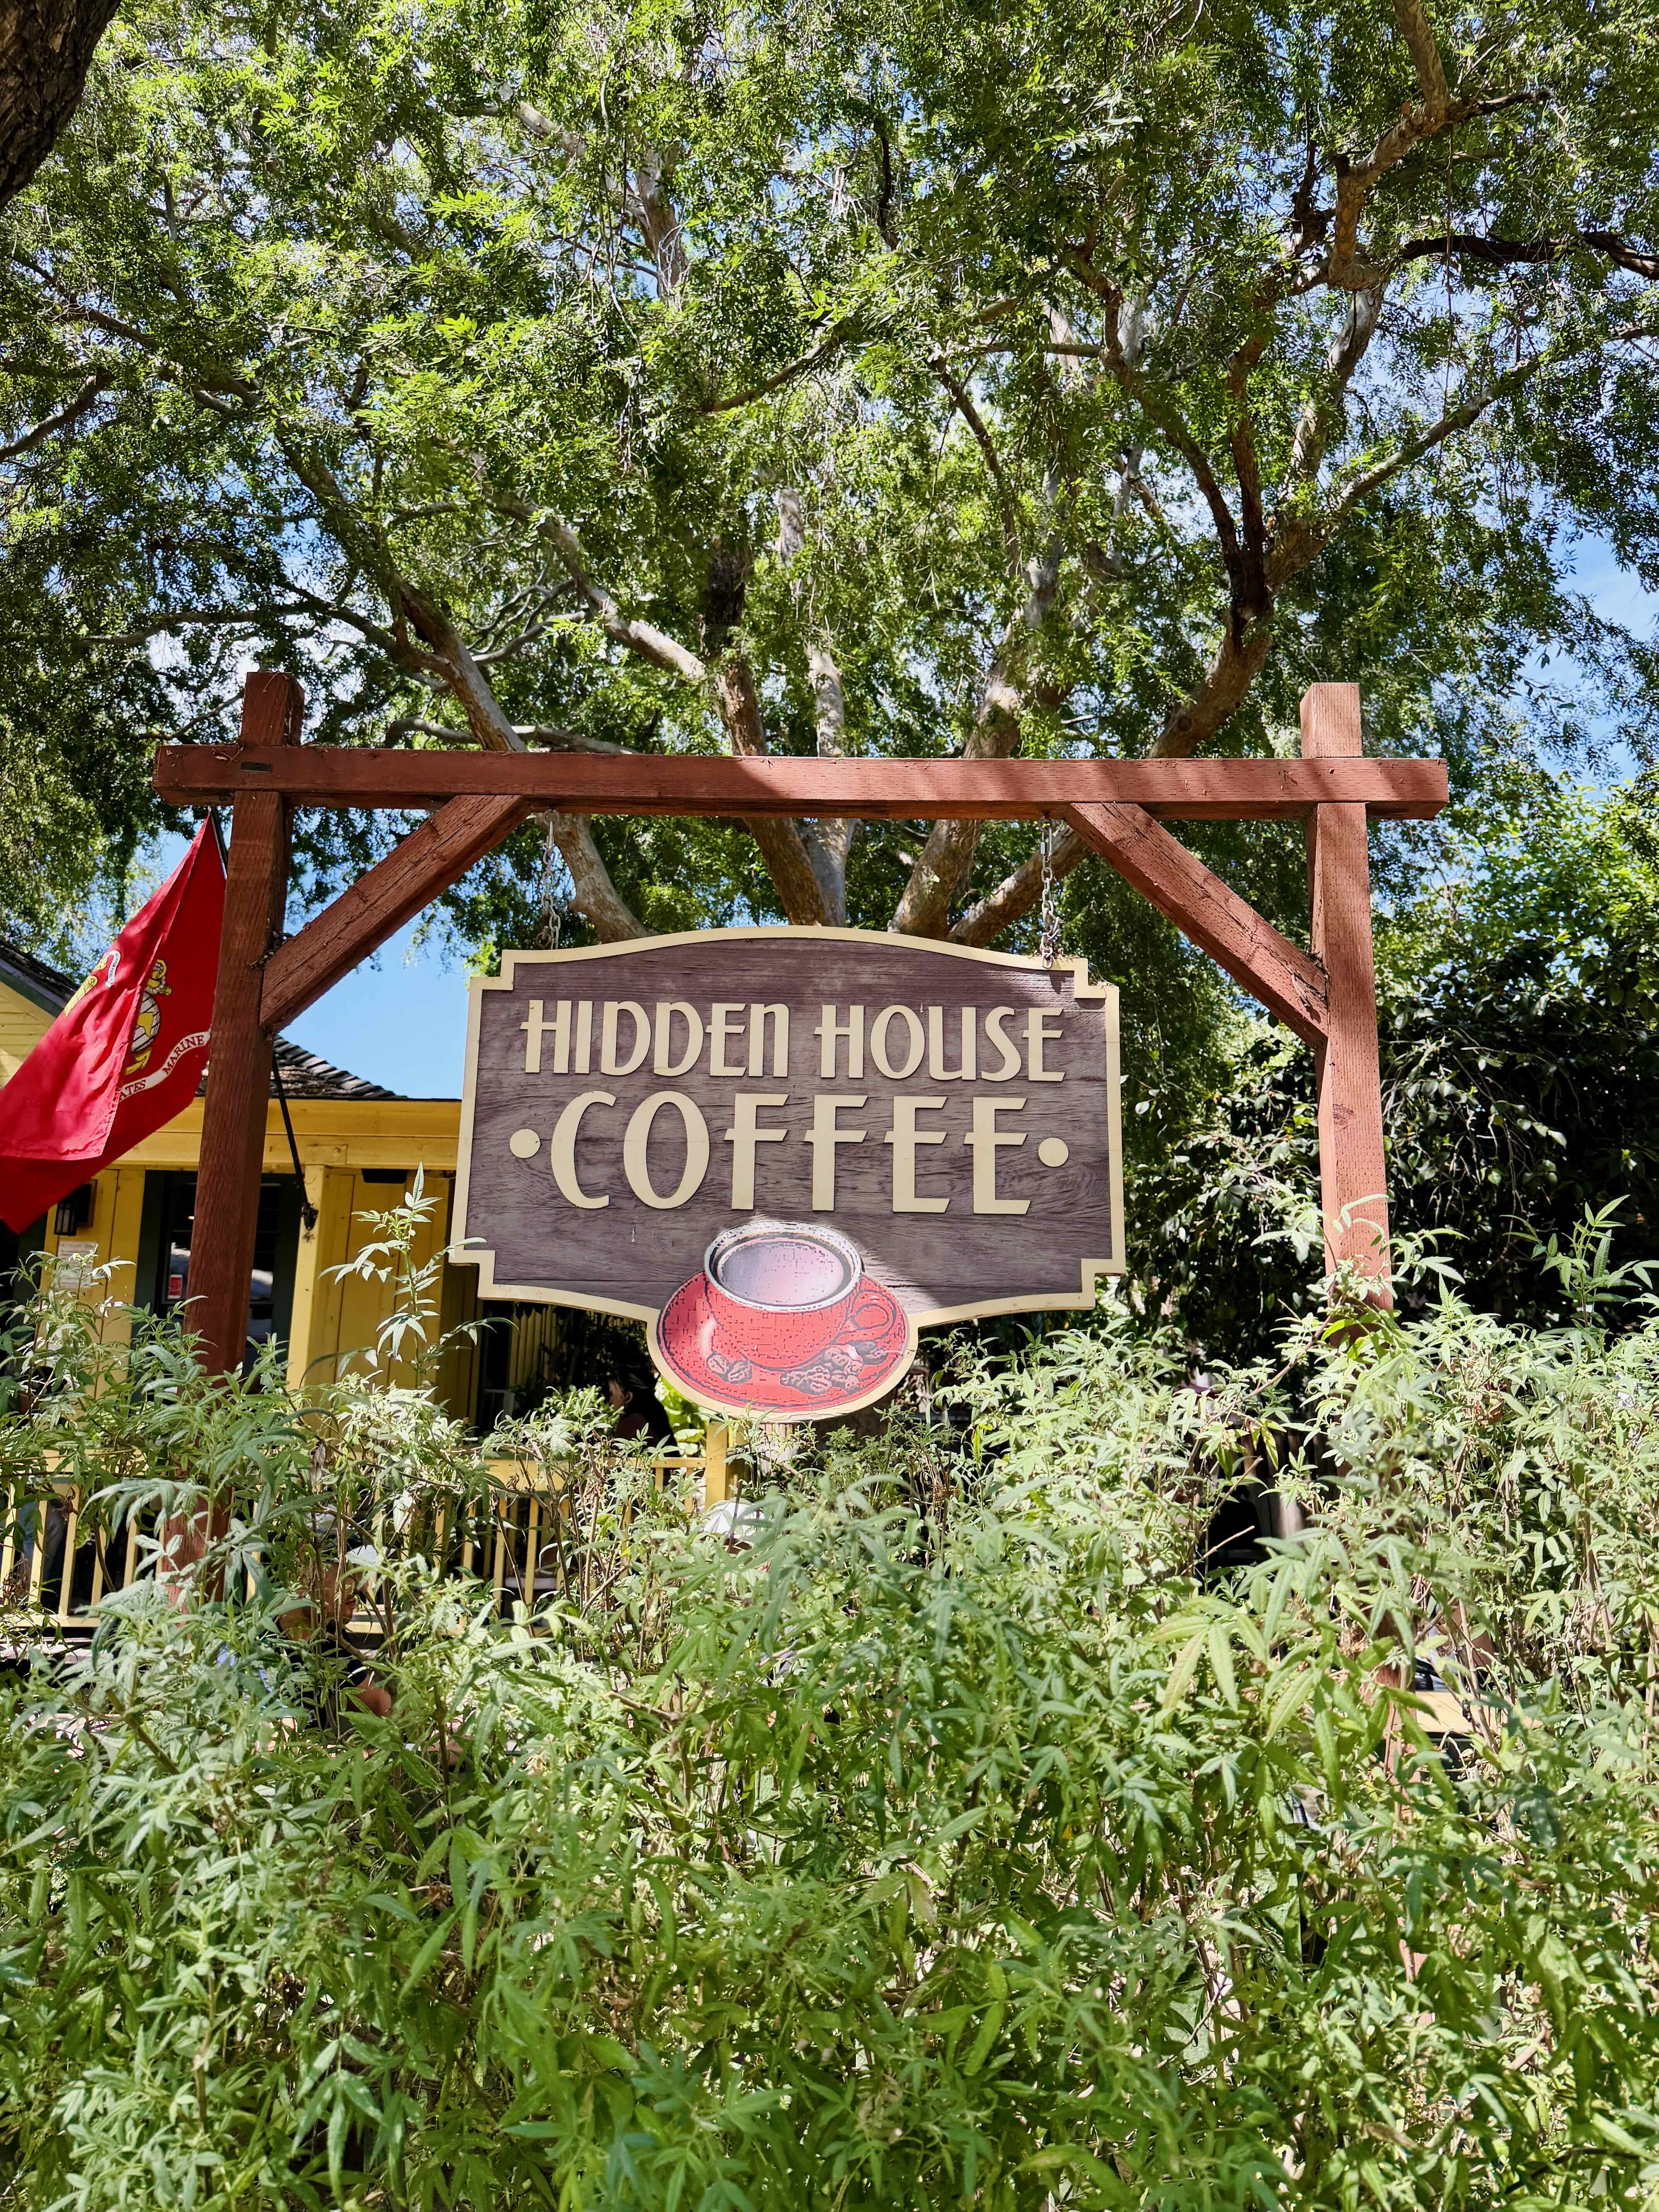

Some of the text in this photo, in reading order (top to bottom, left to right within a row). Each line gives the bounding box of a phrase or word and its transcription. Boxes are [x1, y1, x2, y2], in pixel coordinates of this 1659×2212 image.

[162, 1035, 204, 1075] MARINE
[520, 1000, 1065, 1082] HIDDEN HOUSE
[551, 1091, 1031, 1214] COFFEE
